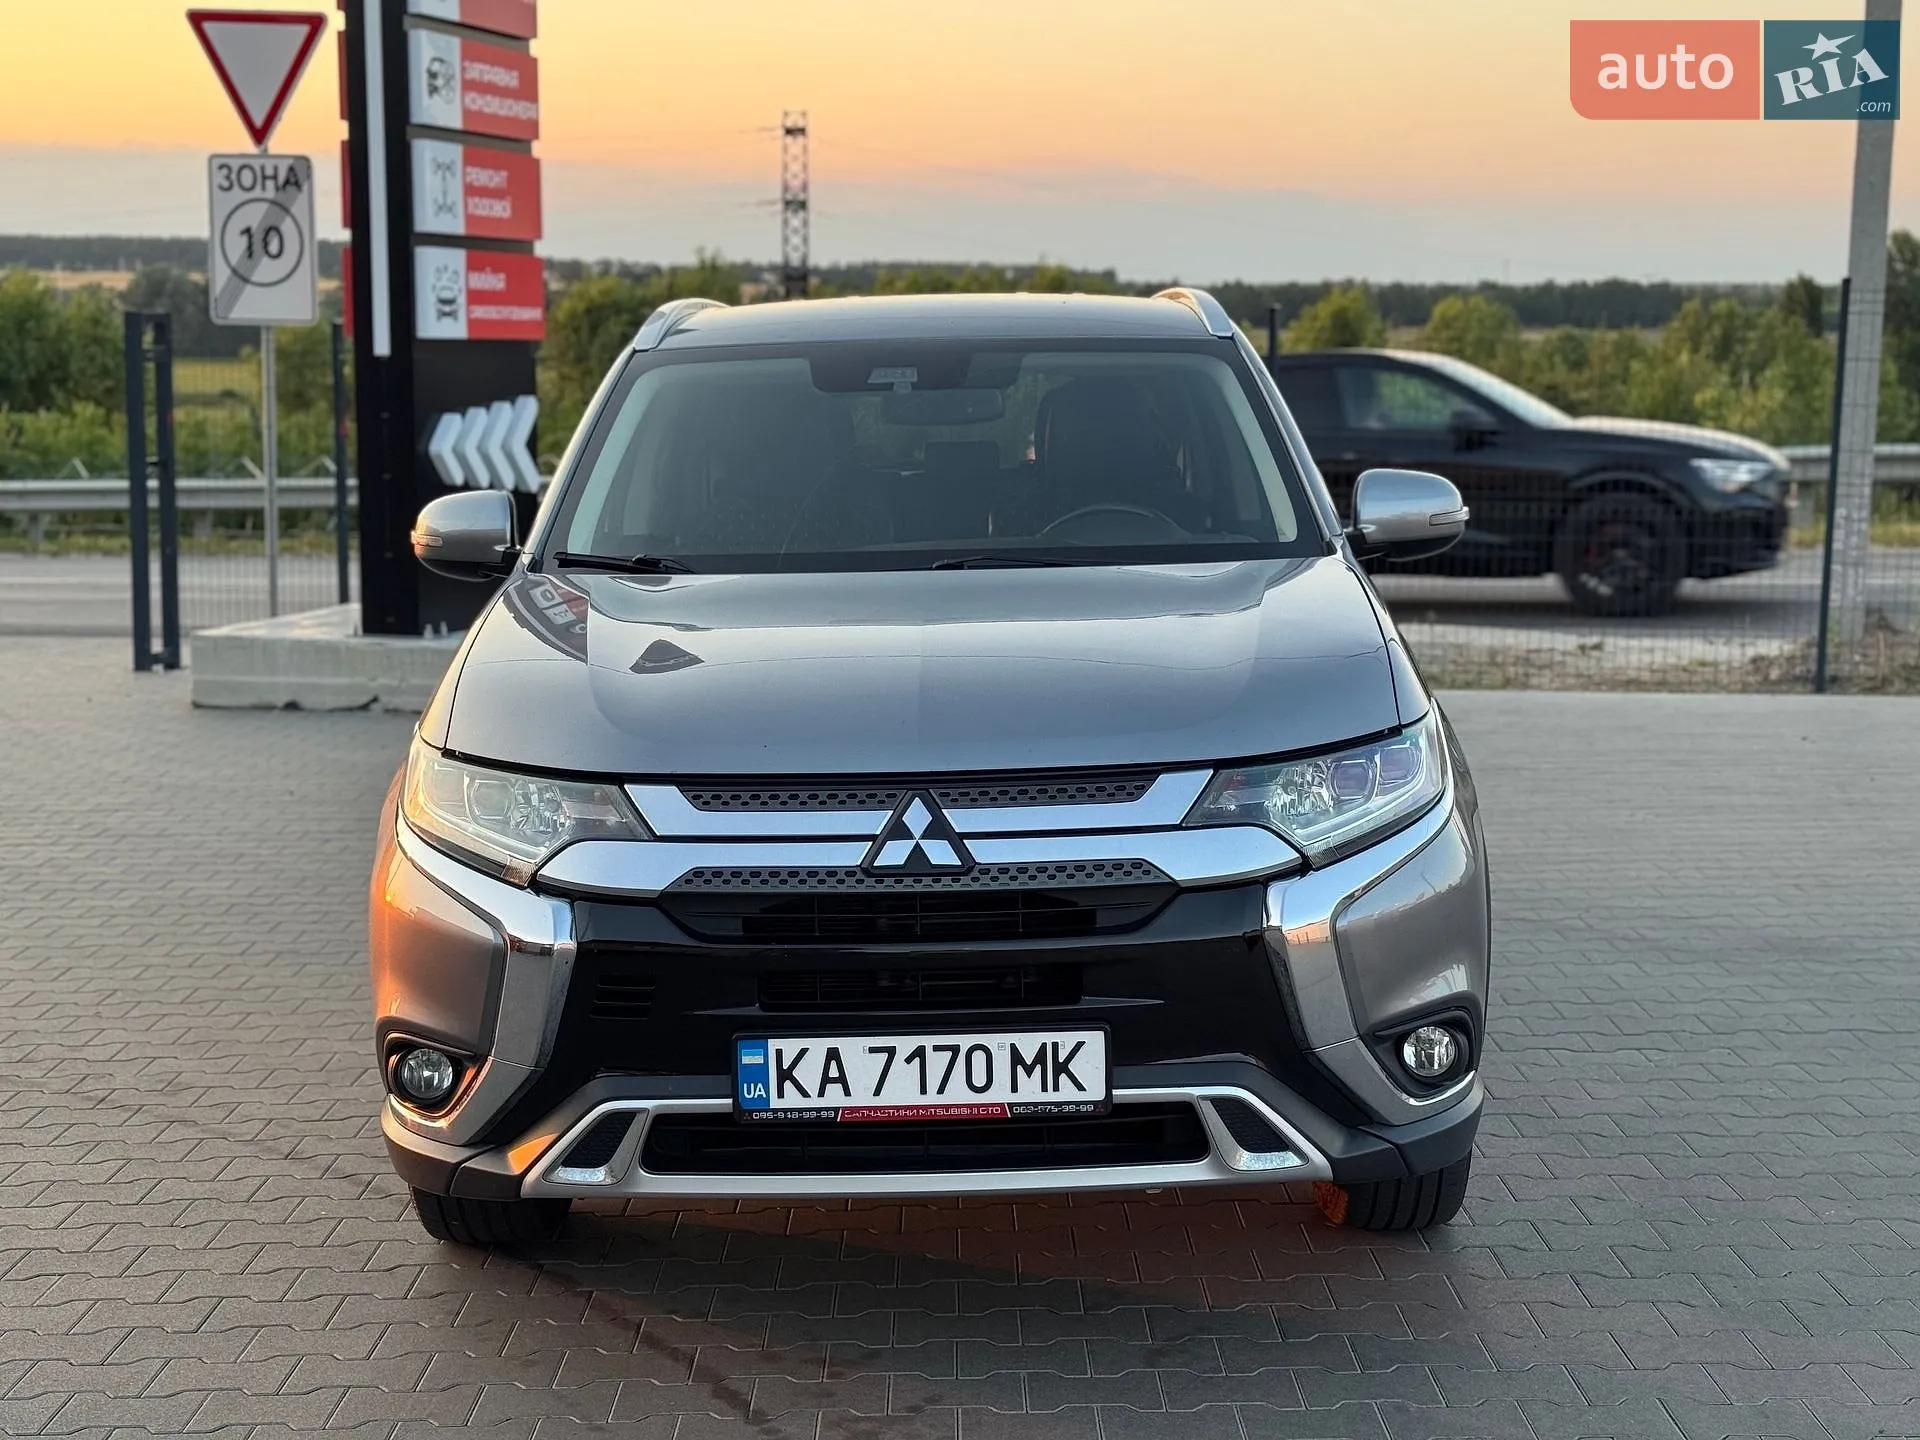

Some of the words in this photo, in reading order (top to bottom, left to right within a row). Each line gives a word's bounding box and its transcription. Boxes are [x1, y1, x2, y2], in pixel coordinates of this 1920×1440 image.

[217, 163, 303, 193] ЗОНА
[240, 225, 284, 259] 10
[775, 1046, 852, 1099] KA
[868, 1043, 994, 1098] 7170
[1009, 1041, 1087, 1093] MK
[743, 1082, 767, 1099] UA
